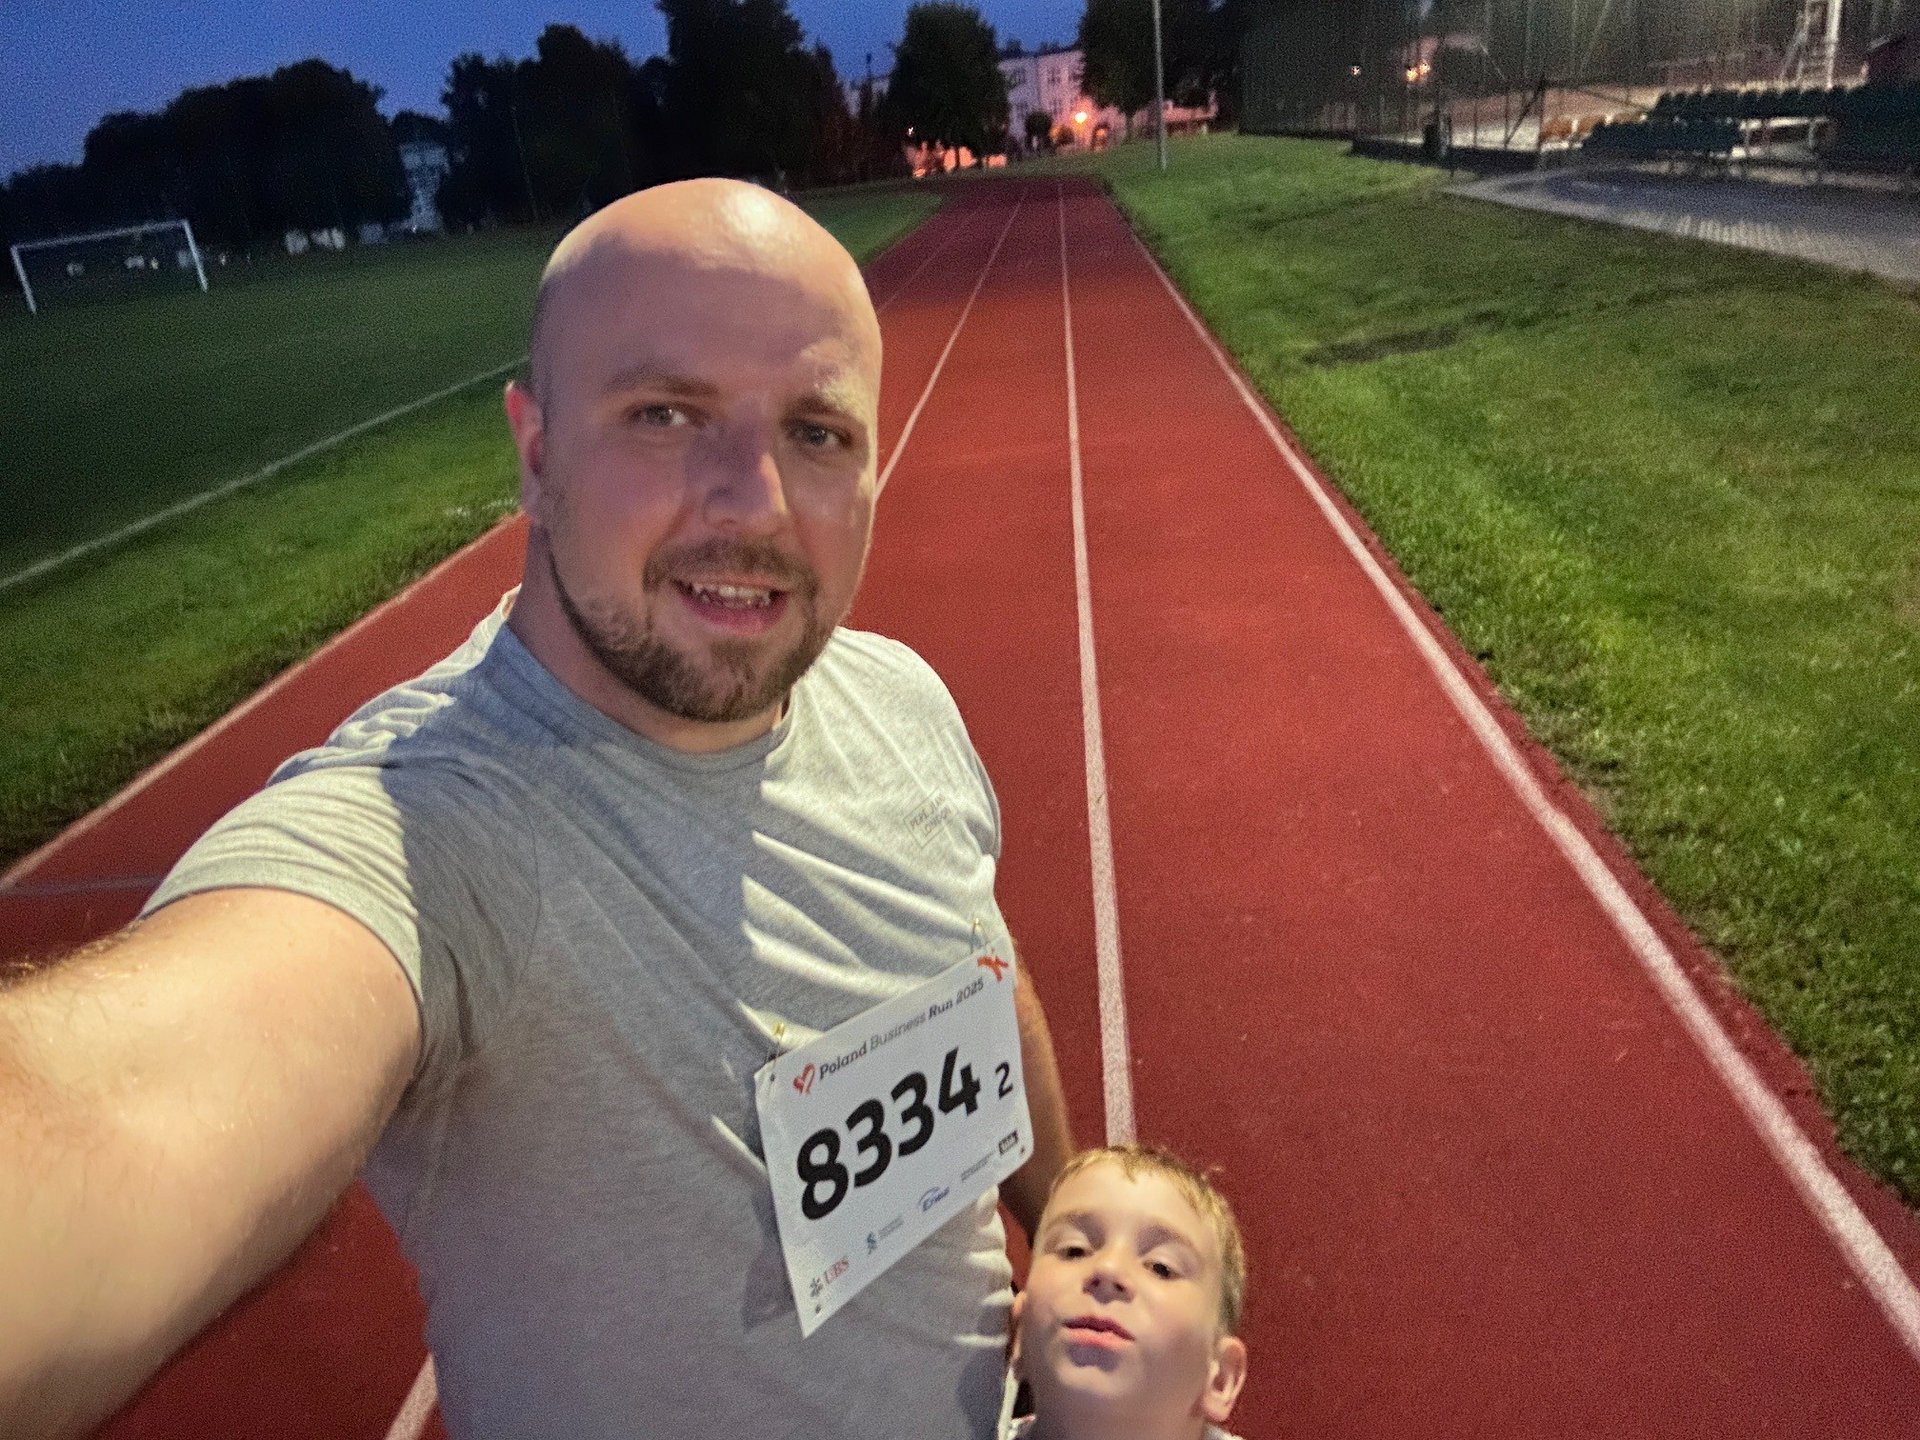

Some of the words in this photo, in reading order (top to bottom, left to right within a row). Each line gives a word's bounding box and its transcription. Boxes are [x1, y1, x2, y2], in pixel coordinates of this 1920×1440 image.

[820, 1041, 867, 1080] Poland
[869, 1012, 926, 1052] Business
[928, 1003, 953, 1020] Run
[956, 976, 984, 1005] 2025
[797, 1047, 980, 1220] 8334
[995, 1061, 1013, 1099] 2
